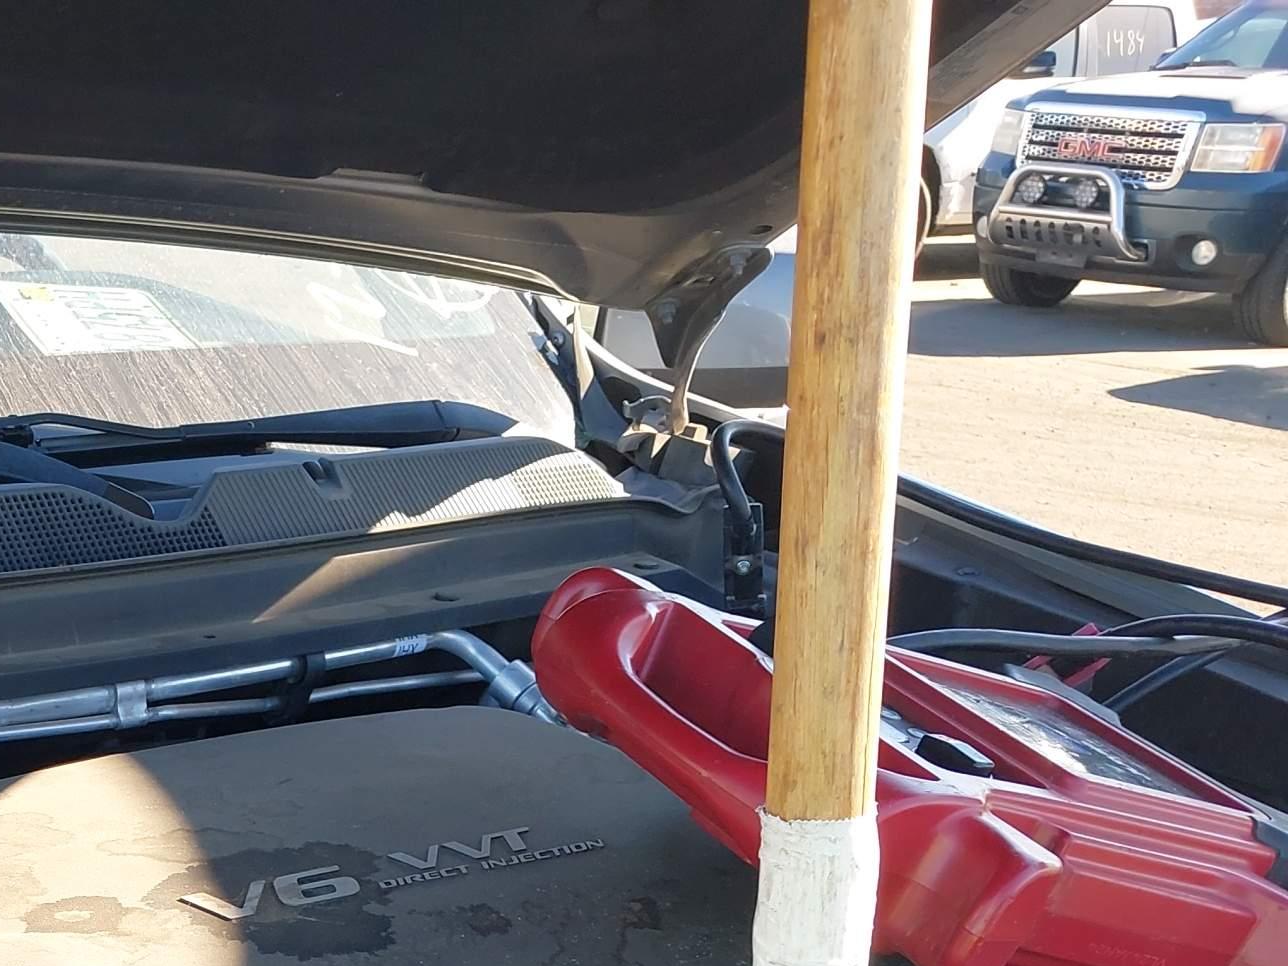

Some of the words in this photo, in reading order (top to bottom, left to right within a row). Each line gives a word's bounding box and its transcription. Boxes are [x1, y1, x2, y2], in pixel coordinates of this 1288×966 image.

[1106, 29, 1145, 57] 1484
[1057, 136, 1127, 160] GMC
[176, 864, 361, 922] V6
[386, 826, 530, 870] VVT
[378, 864, 470, 890] DIRECT
[480, 838, 606, 870] INJECTION
